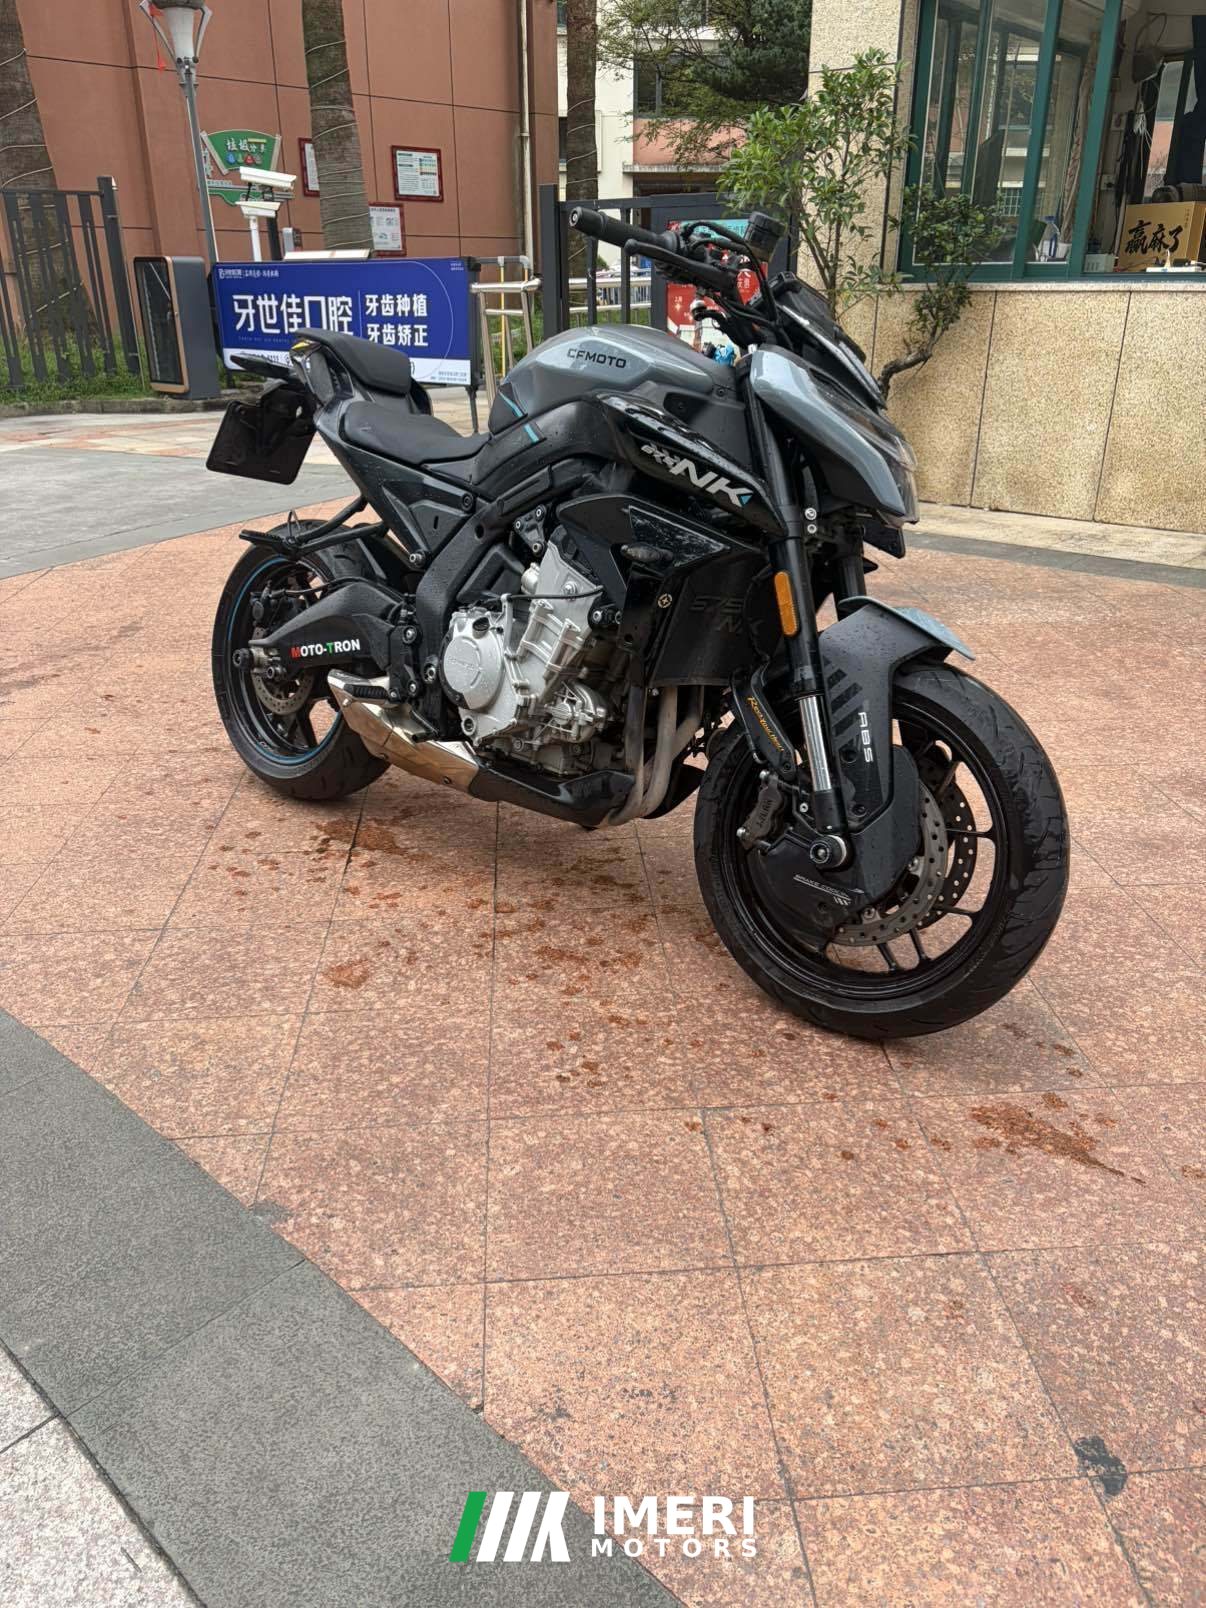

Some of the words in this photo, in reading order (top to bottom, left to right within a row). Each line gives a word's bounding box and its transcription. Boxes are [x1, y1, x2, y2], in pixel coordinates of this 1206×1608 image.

[1125, 219, 1183, 255] 赢麻了
[232, 293, 353, 336] 牙世佳口腔
[365, 293, 428, 317] 牙齿种植
[367, 323, 429, 346] 牙齿矫正
[566, 348, 627, 369] CFMOTO
[290, 638, 361, 660] MOTO-TRON
[858, 711, 874, 763] ABS
